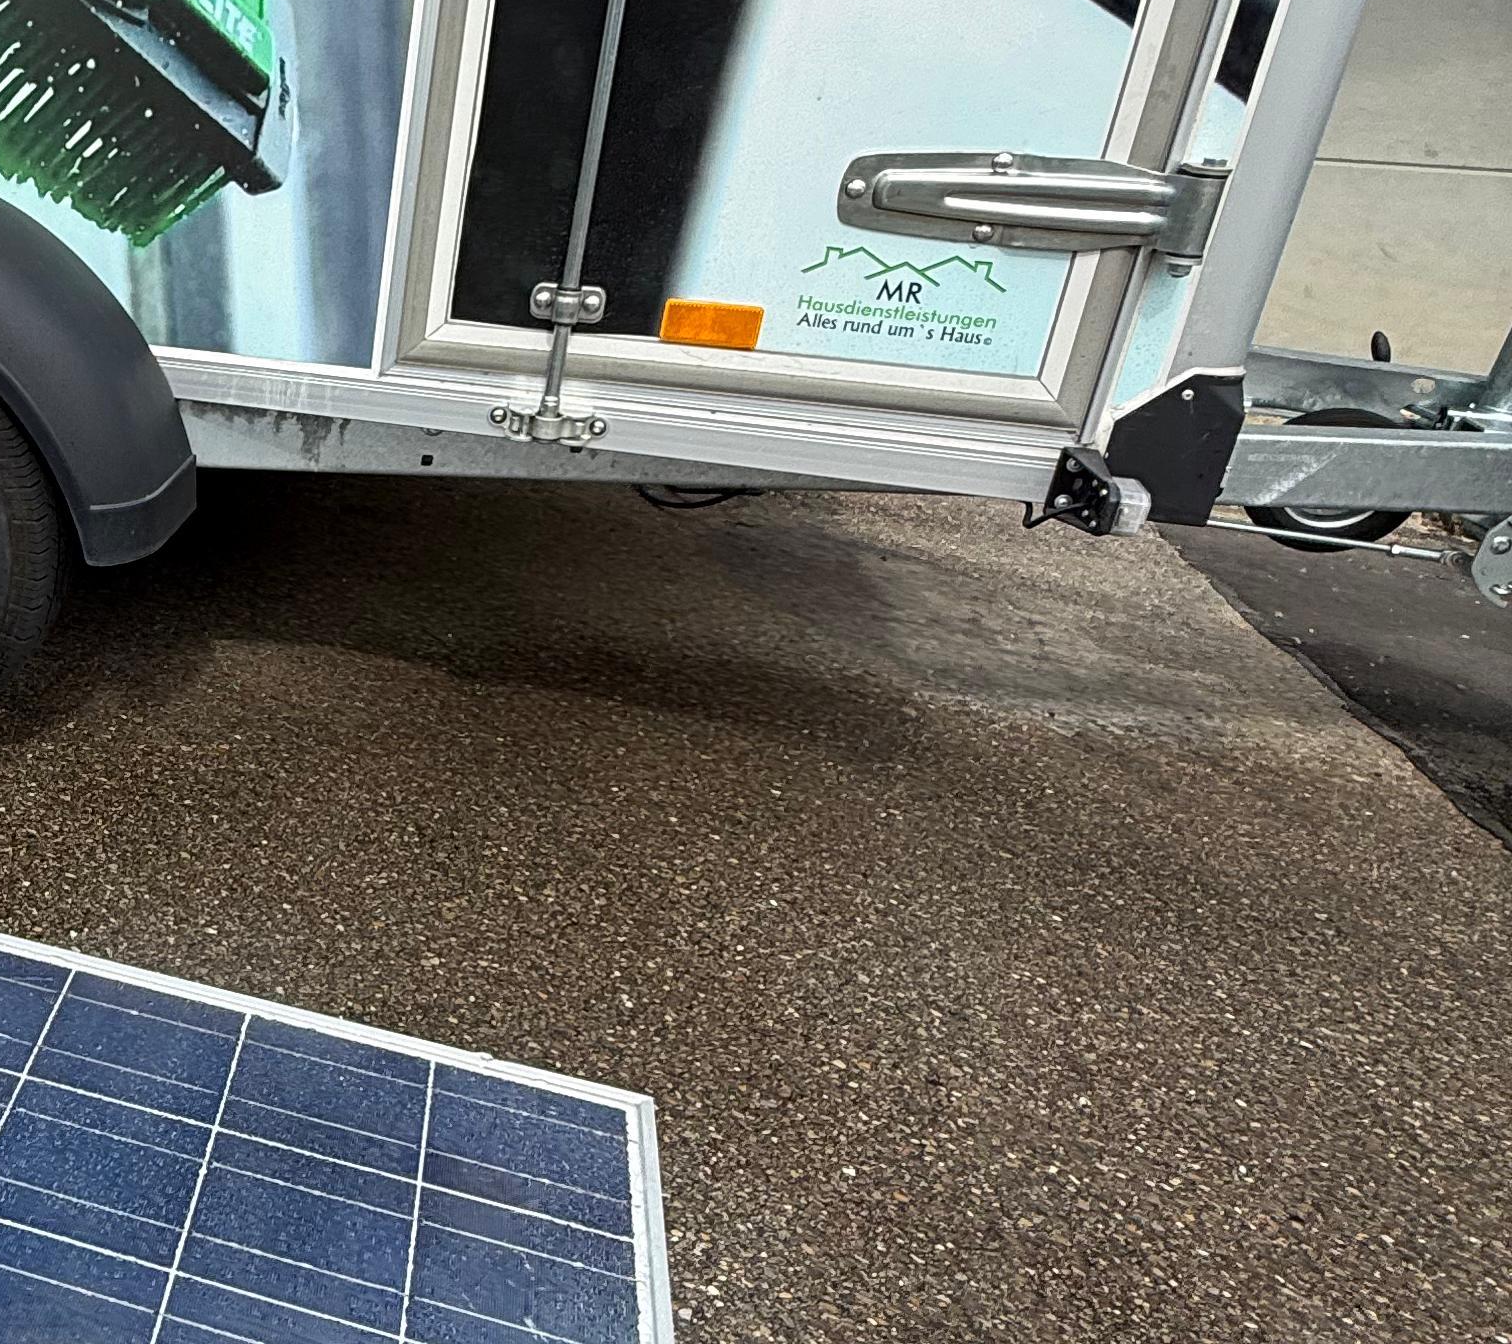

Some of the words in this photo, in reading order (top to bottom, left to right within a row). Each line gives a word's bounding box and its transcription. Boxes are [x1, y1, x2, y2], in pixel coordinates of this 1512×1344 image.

[876, 279, 923, 305] MR
[796, 312, 838, 330] Alles
[842, 319, 883, 335] rund
[797, 294, 997, 330] Hausdienstleistungen
